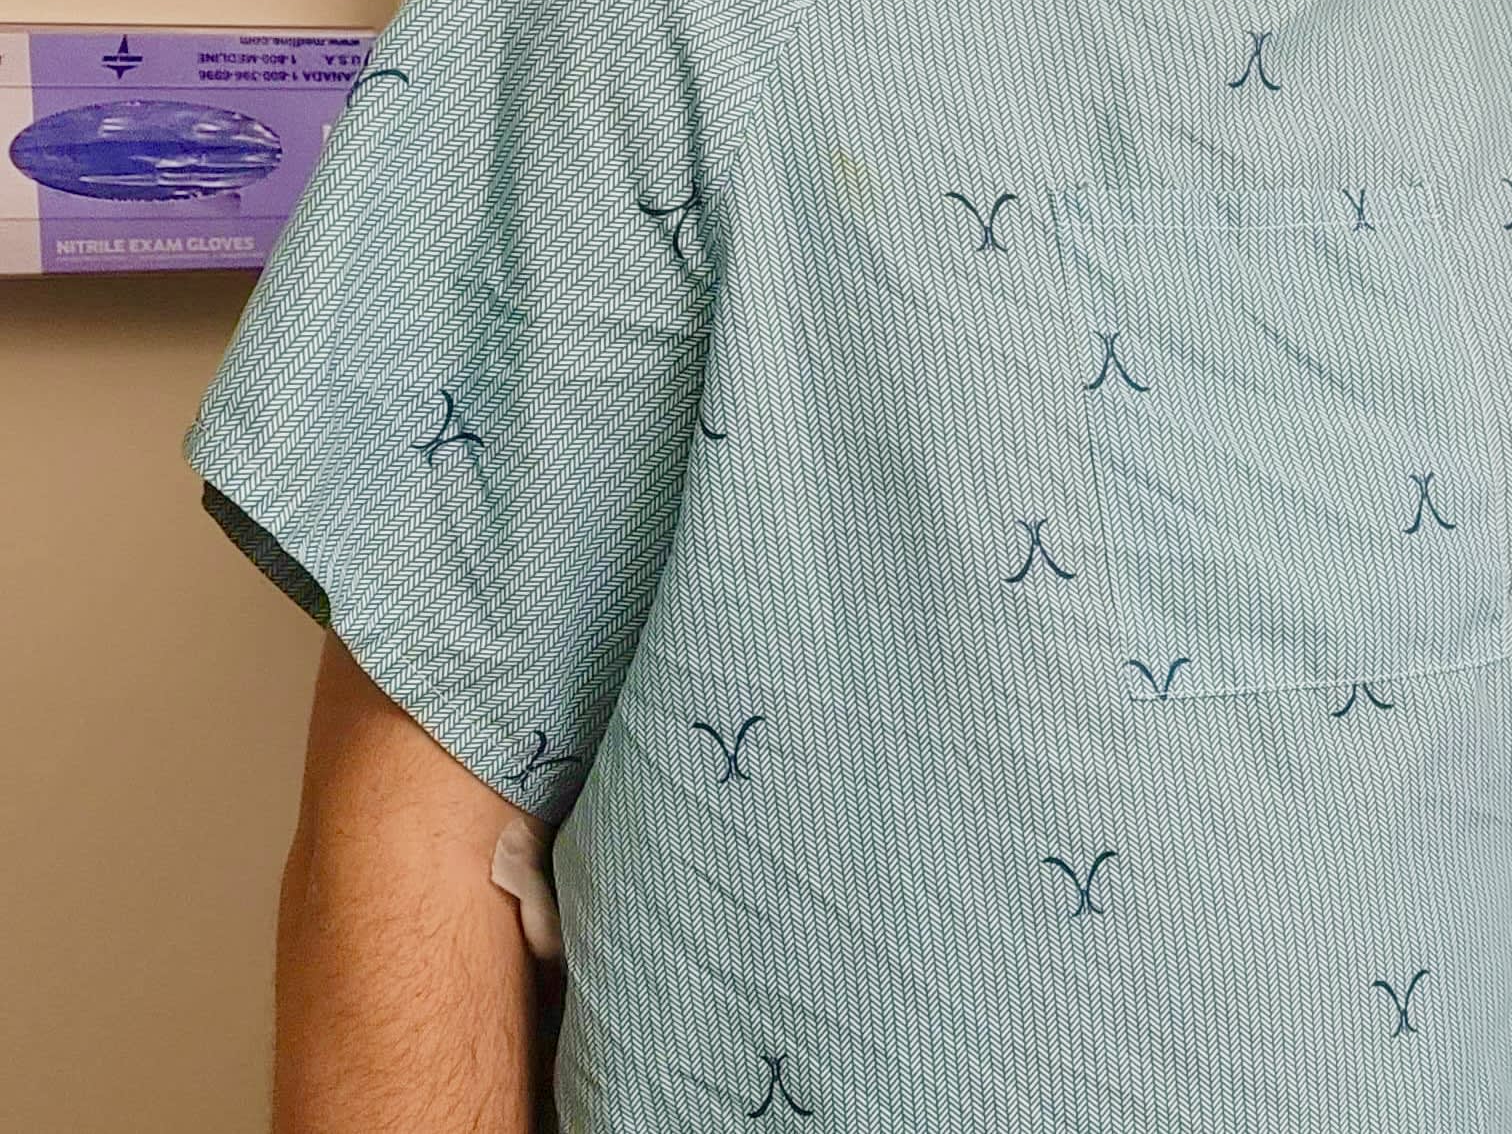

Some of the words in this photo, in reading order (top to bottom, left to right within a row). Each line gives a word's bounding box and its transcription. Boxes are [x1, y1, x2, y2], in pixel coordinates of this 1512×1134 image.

[303, 69, 357, 83] ANADA
[56, 239, 125, 254] NITRILE
[129, 238, 183, 252] EXAM
[187, 236, 255, 252] GLOVES
